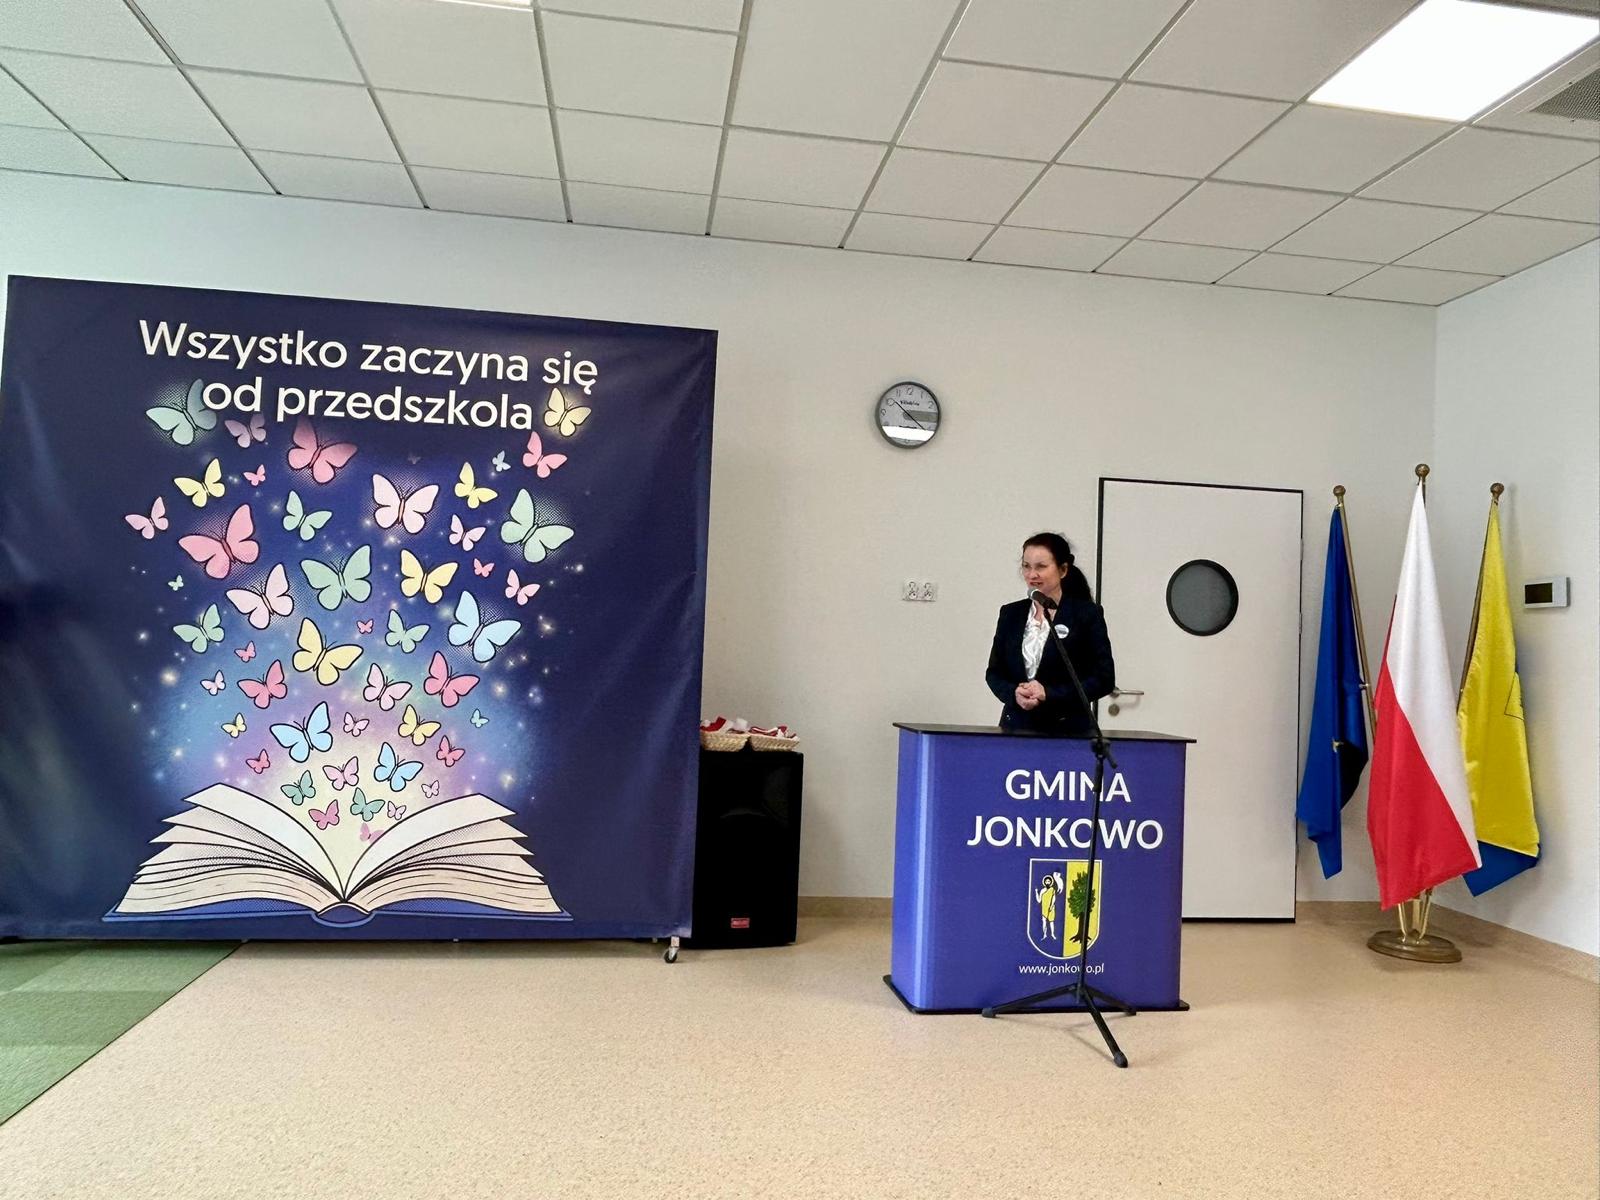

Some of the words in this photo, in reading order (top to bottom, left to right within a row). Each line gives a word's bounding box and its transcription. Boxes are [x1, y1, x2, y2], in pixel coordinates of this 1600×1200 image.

[139, 319, 348, 370] Wszystko
[360, 343, 529, 385] zaczyna
[542, 350, 598, 395] się
[203, 377, 262, 412] od
[277, 385, 533, 430] przedszkola
[1005, 769, 1132, 803] GMINA
[966, 815, 1164, 850] JONKOWO
